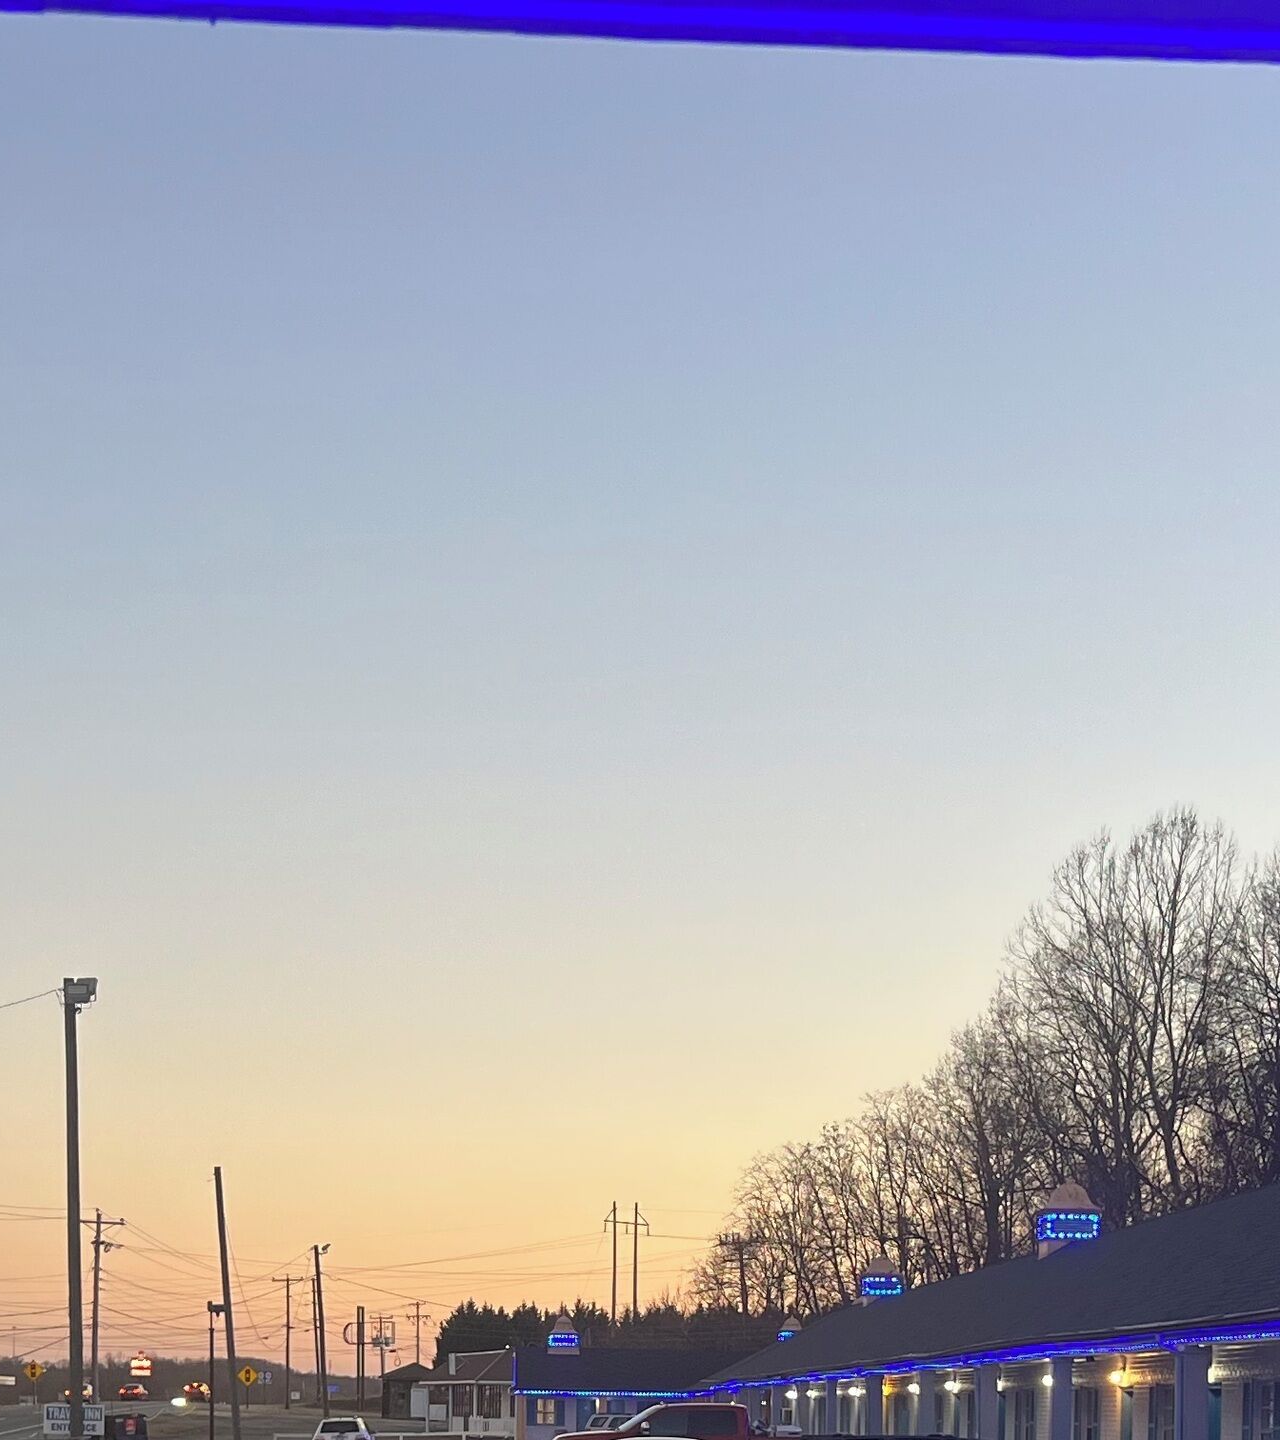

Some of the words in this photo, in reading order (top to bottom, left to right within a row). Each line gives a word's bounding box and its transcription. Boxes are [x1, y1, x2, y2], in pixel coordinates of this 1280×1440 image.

[48, 1407, 71, 1419] TRAV
[84, 1407, 101, 1420] INN
[51, 1423, 97, 1432] ENTCE
